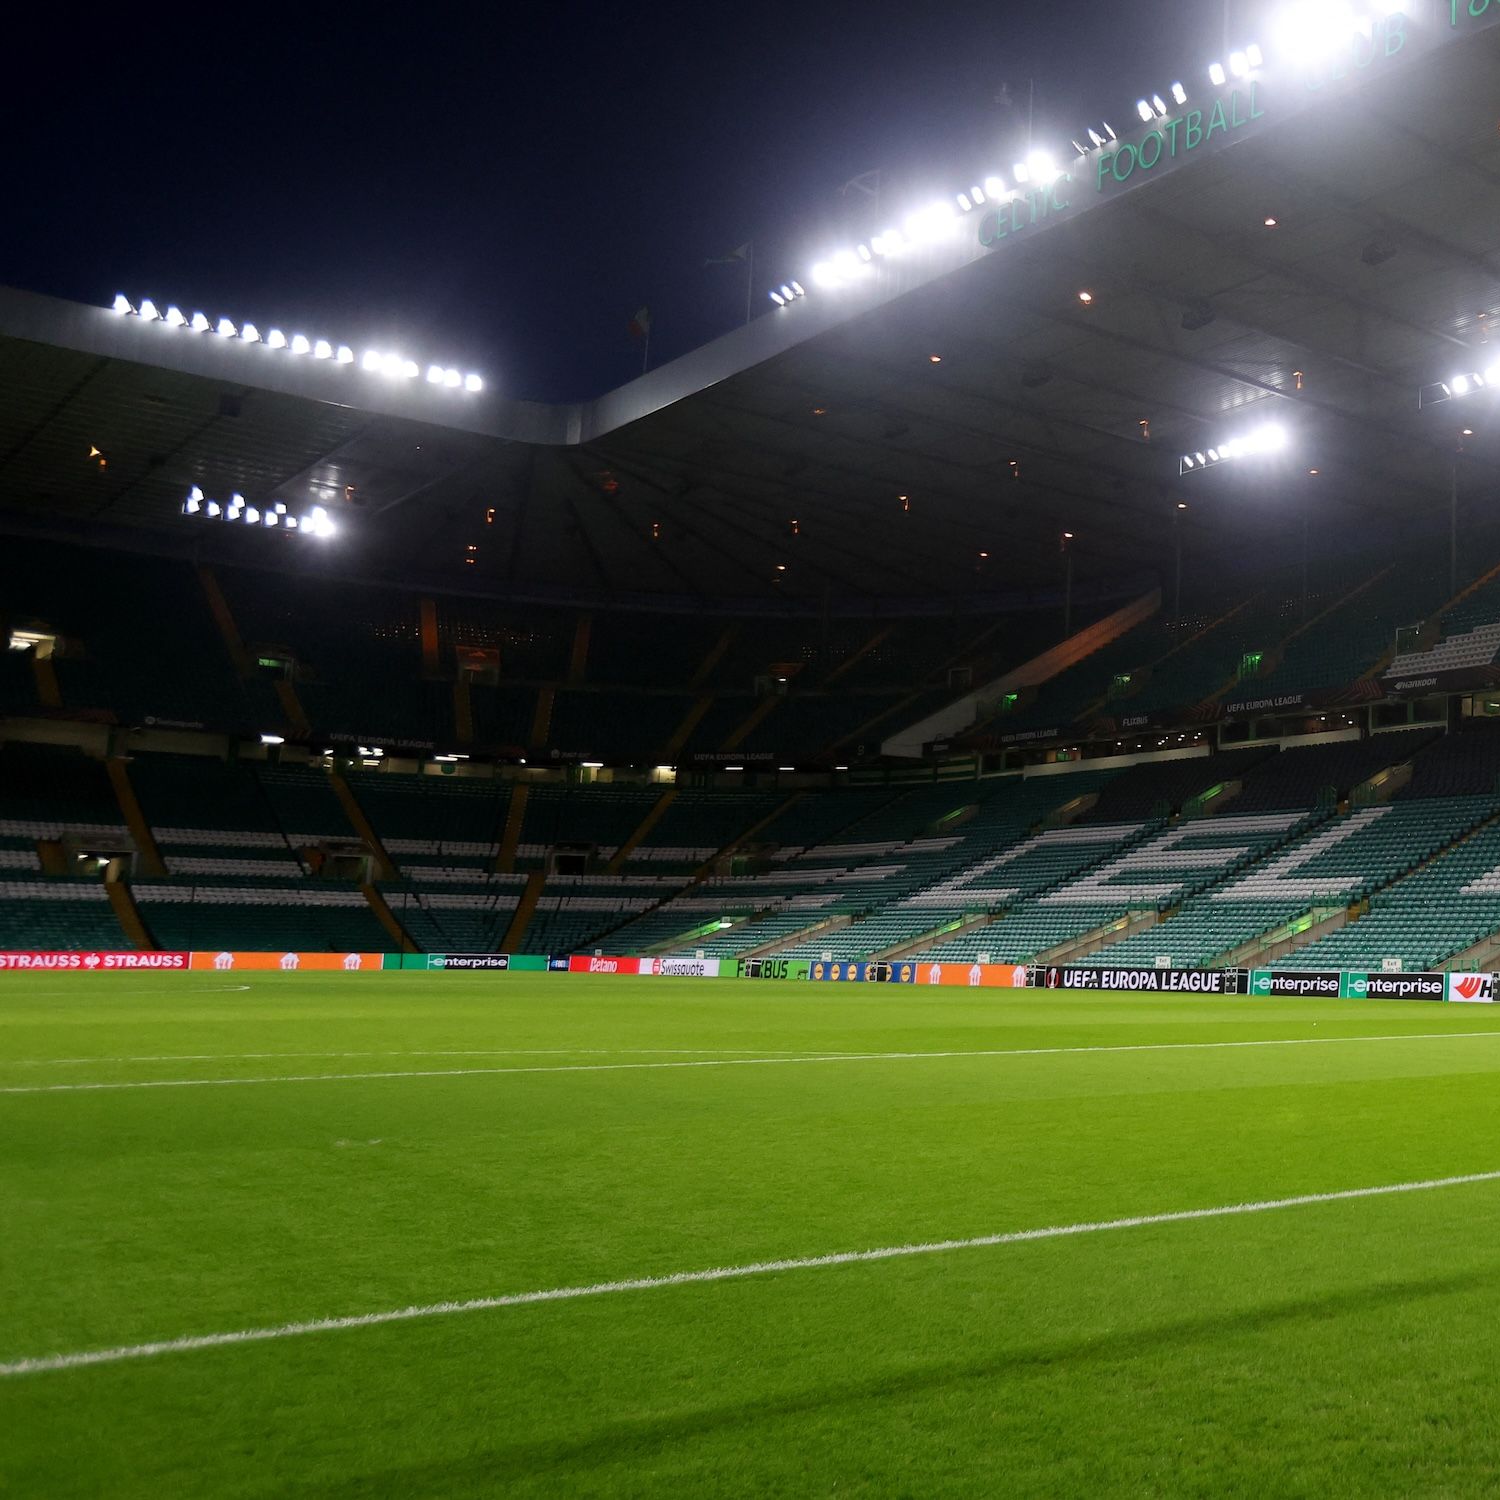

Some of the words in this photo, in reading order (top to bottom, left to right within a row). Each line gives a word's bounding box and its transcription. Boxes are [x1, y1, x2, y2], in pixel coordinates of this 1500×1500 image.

[978, 174, 1070, 247] CELTIC
[1096, 80, 1265, 193] FOOTBALL
[1227, 702, 1245, 713] UEFA
[1246, 699, 1273, 710] EUROPA
[1275, 695, 1302, 706] LEAGUE
[104, 955, 183, 967] STRAUSS
[432, 957, 508, 967] enterprise
[590, 957, 617, 972] Betano
[661, 960, 704, 976] Swissquote
[737, 960, 788, 979] FBUS
[1064, 970, 1098, 987] UEFA
[1101, 971, 1158, 989] EUROPA
[1161, 972, 1221, 991] LEAGUE
[1258, 977, 1338, 995] enterprise
[1354, 978, 1442, 997] enterprise
